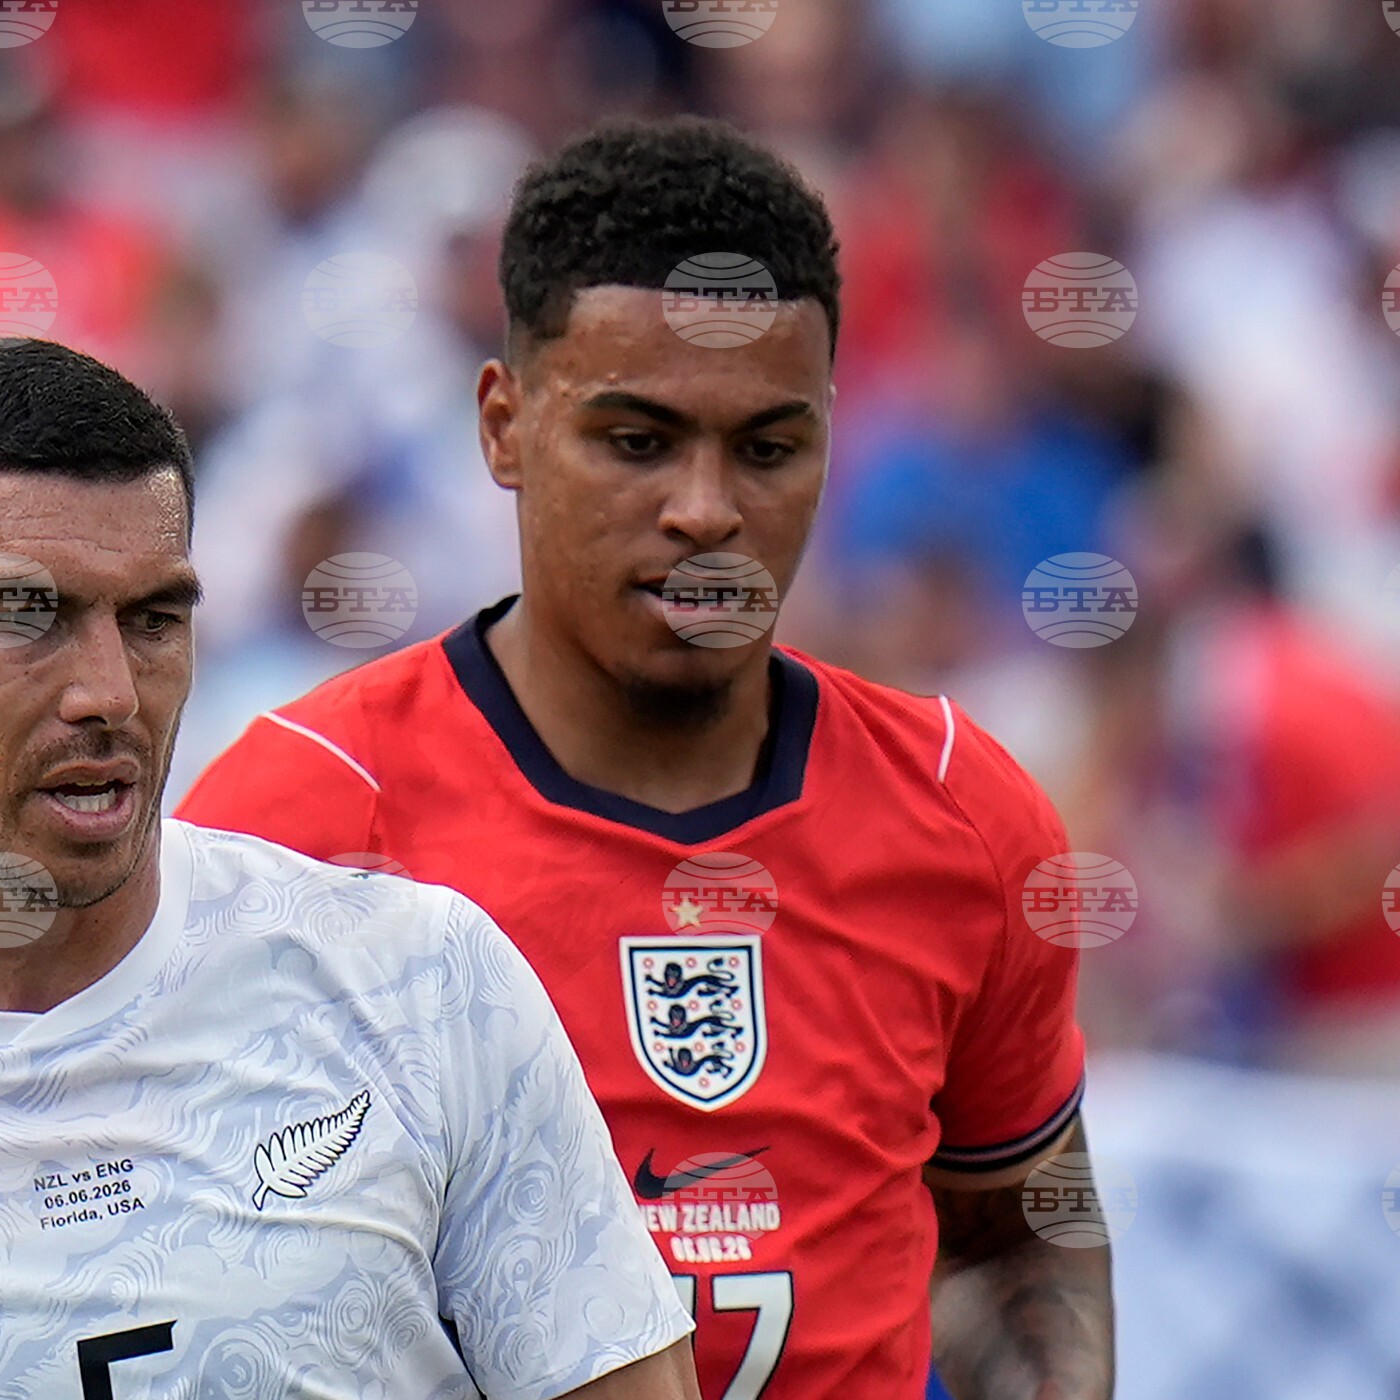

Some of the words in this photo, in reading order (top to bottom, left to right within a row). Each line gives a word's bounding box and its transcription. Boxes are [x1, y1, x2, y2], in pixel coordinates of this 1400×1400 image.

[34, 1173, 68, 1191] NZL
[72, 1170, 91, 1183] vs
[96, 1159, 134, 1178] ENG
[44, 1179, 132, 1210] 06.06.2026
[40, 1208, 104, 1230] Florida,
[107, 1197, 145, 1216] USA
[681, 1202, 781, 1233] ZEALAND
